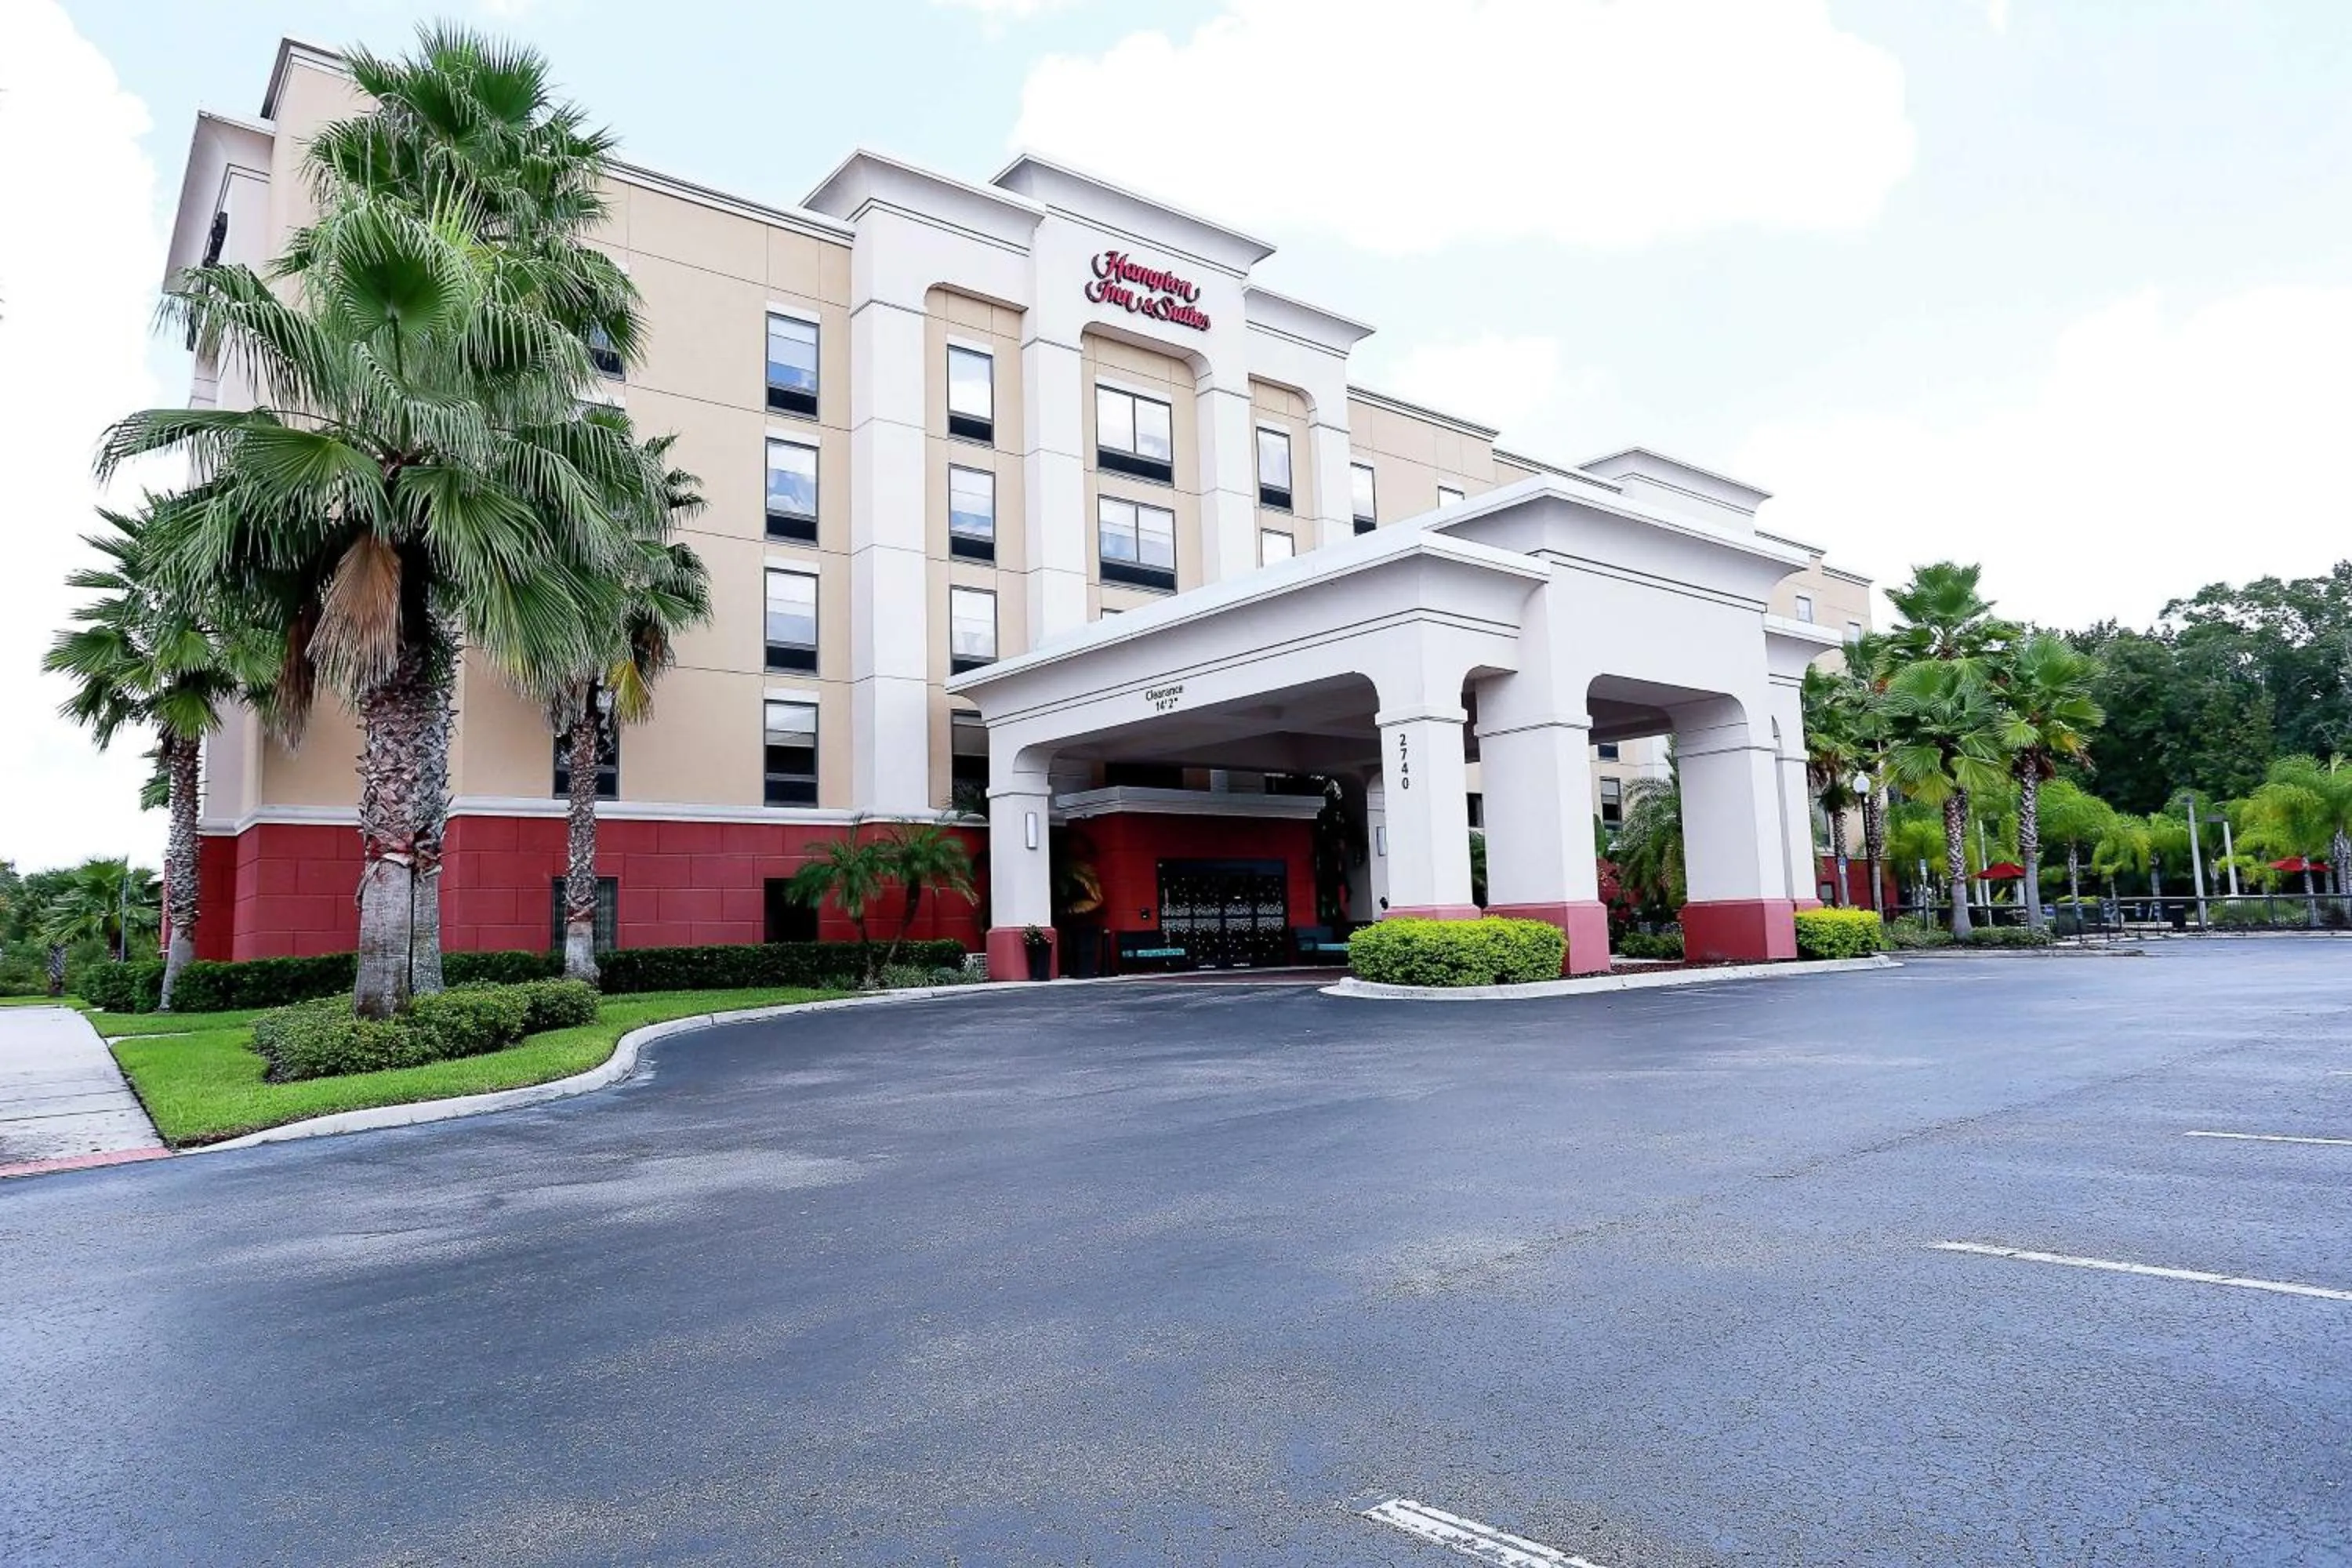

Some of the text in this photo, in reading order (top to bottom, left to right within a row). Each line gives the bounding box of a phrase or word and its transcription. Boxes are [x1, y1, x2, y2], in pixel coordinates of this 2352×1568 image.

[1091, 250, 1200, 303] Hampton
[1084, 279, 1211, 331] Inn & Suites
[1145, 684, 1183, 701] Clearance
[1399, 733, 1410, 790] 2740
